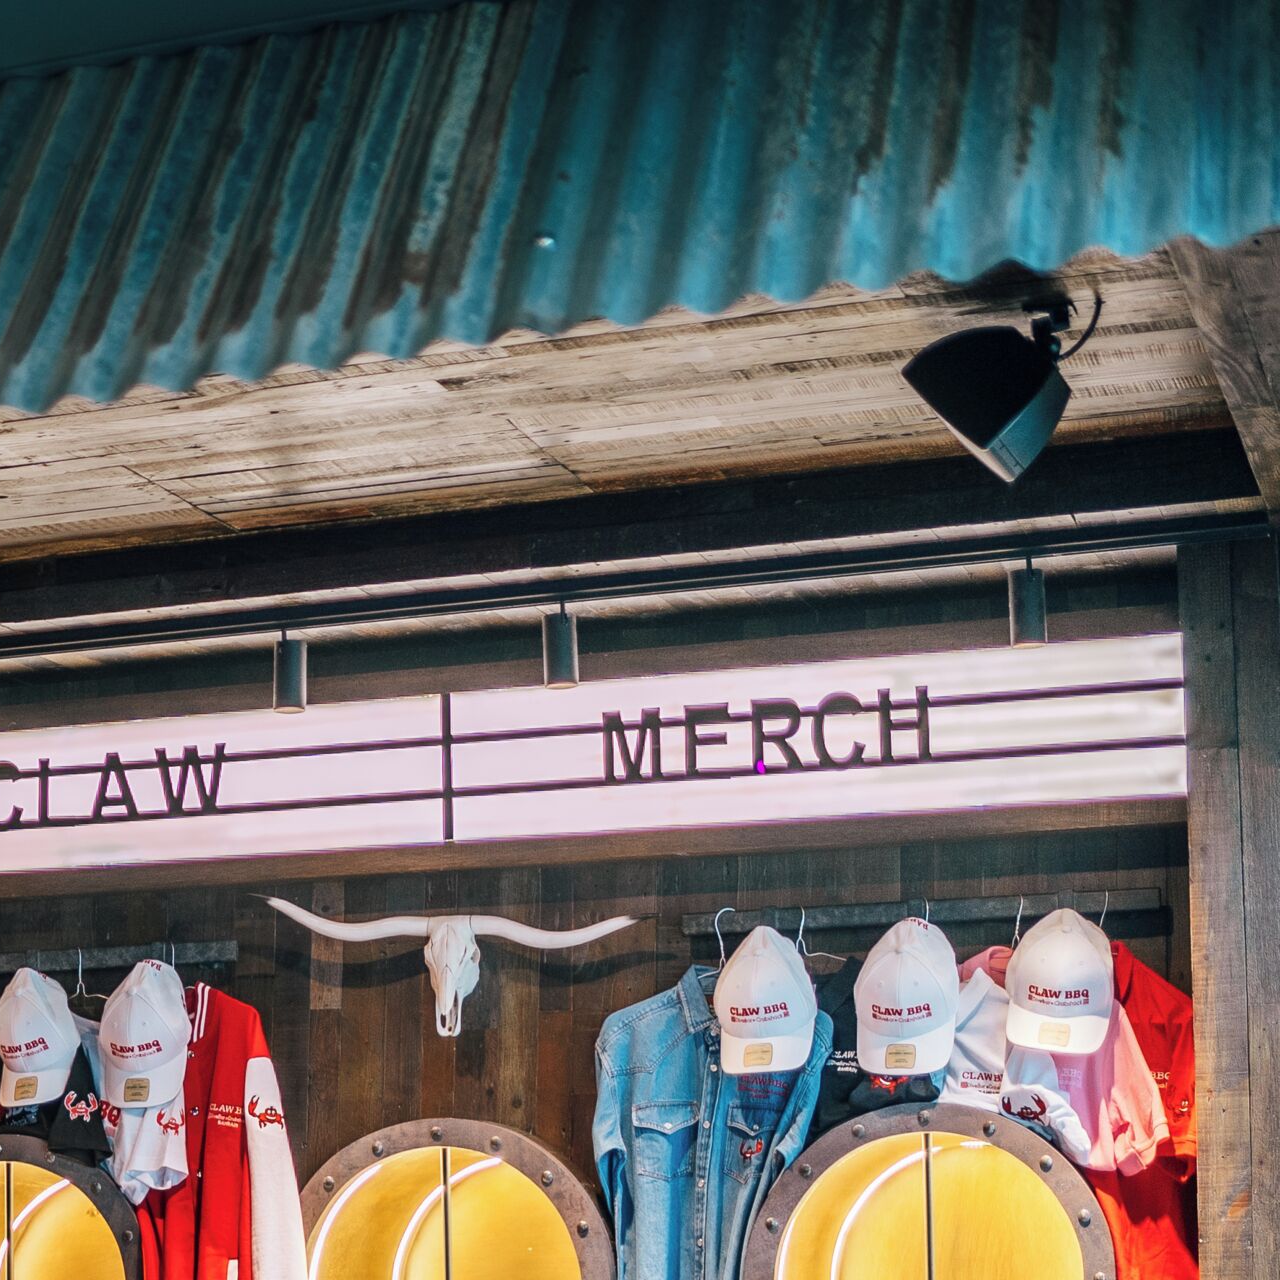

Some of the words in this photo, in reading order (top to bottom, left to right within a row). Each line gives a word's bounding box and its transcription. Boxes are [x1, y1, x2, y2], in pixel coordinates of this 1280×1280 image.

[601, 684, 934, 784] MERCH
[1028, 984, 1062, 999] CLAW
[1064, 989, 1090, 1000] BBQ
[729, 1005, 760, 1017] CLAW
[763, 1002, 789, 1014] BBQ
[871, 1003, 904, 1017] CLAW
[907, 1003, 932, 1015] BBQ
[0, 1042, 23, 1055] CLAW
[23, 1036, 46, 1051] BBQ
[110, 1042, 135, 1054] CLAW
[137, 1039, 161, 1051] BBQ
[961, 1071, 992, 1082] CLAW
[209, 1102, 234, 1114] CLAW
